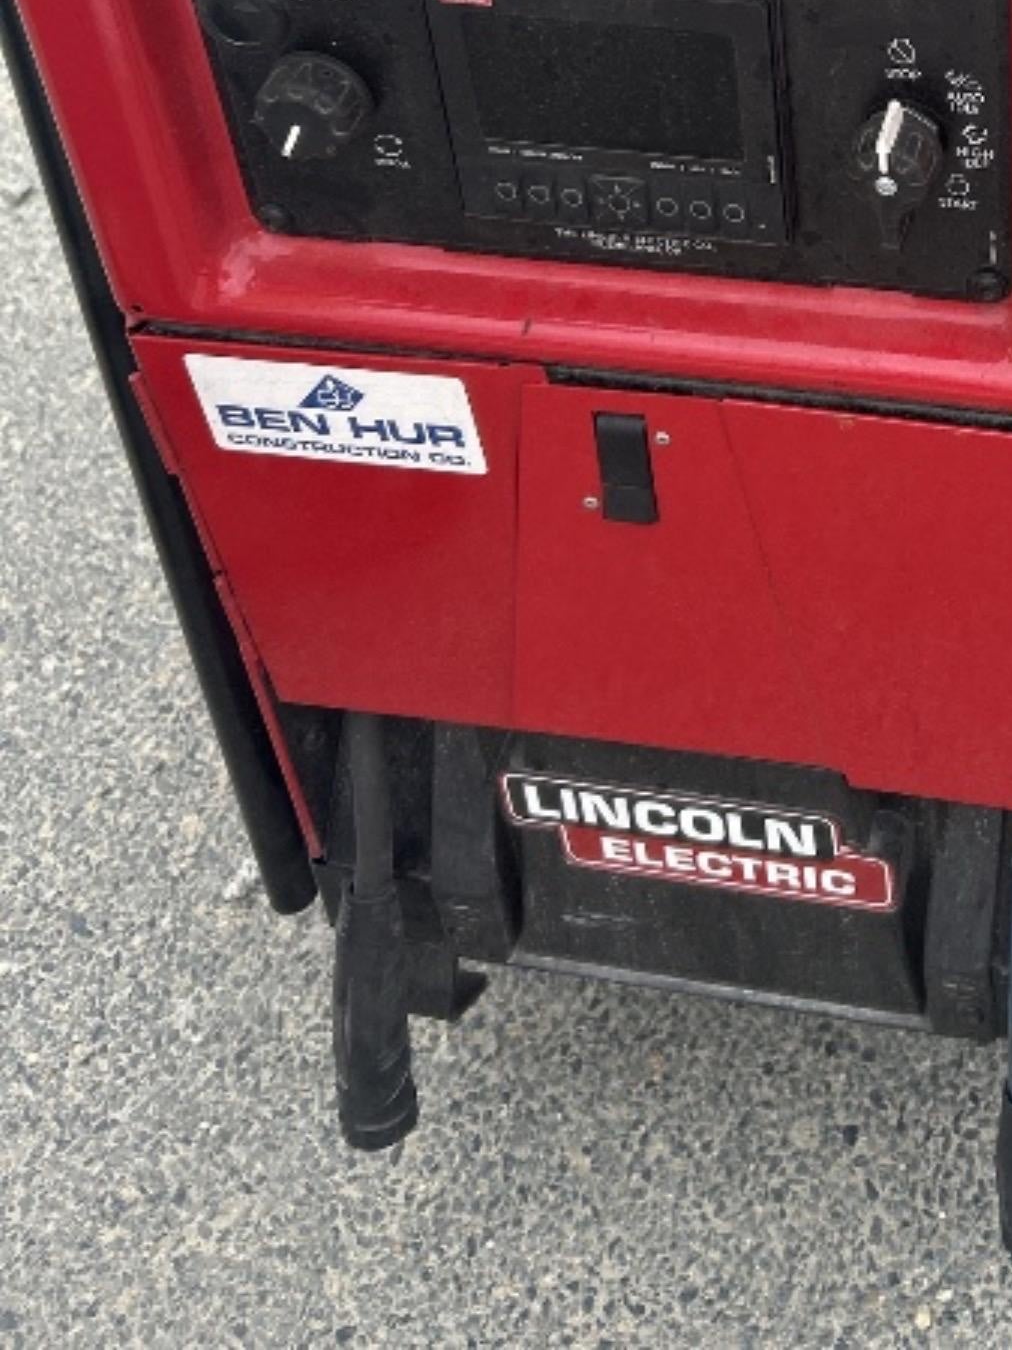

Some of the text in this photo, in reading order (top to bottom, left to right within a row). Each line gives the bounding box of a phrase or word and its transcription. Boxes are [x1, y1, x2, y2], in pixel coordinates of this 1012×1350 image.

[955, 146, 995, 160] HIGH
[215, 404, 466, 448] BEN HUR
[227, 432, 421, 463] CONSTRUCTION
[521, 783, 819, 857] LINCOLN
[600, 836, 857, 896] ELECTRIC
